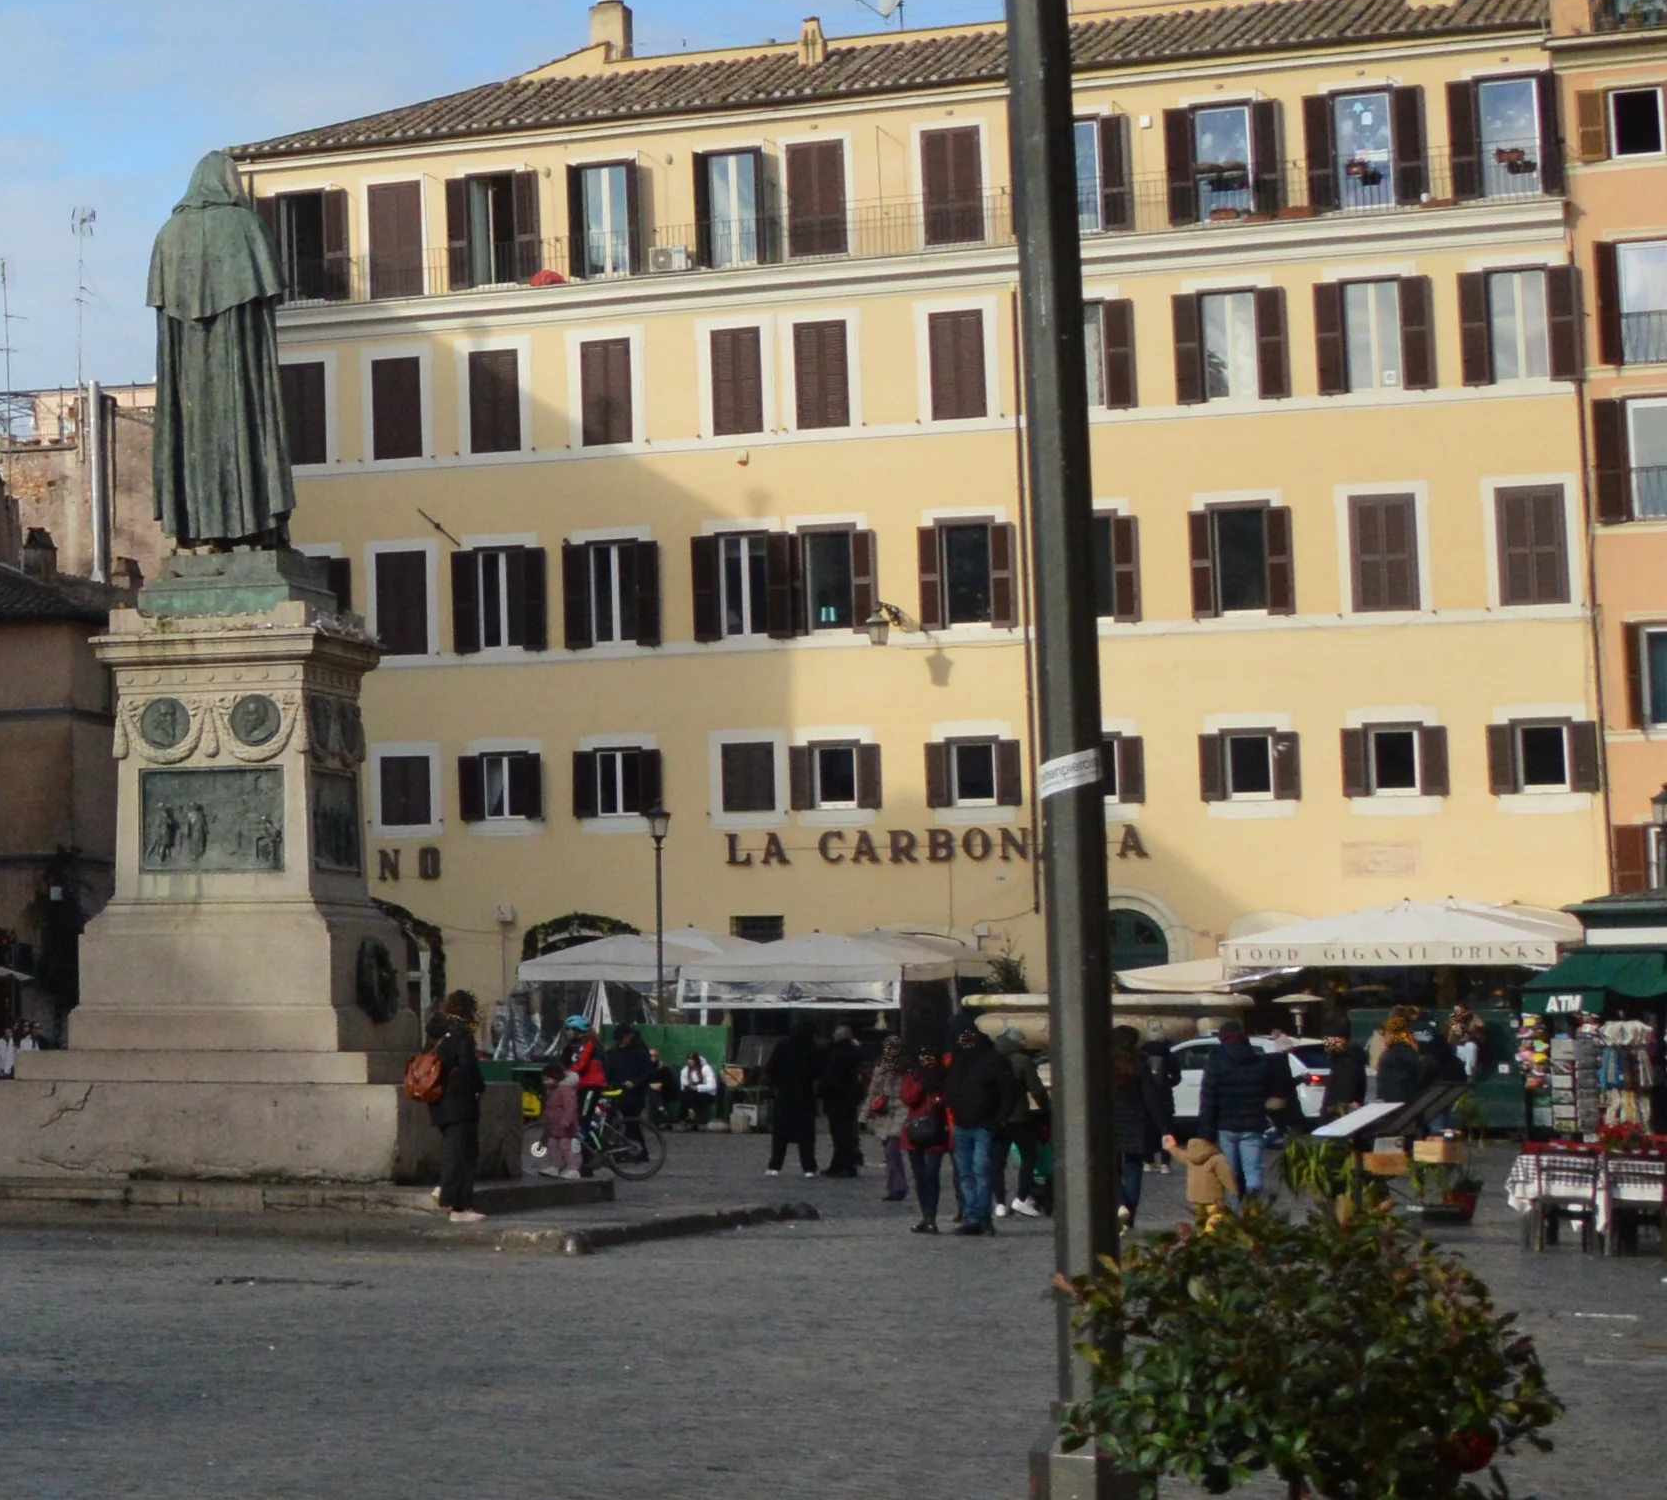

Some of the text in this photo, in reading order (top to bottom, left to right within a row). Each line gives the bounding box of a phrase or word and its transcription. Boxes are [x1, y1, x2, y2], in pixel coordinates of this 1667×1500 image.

[724, 823, 1151, 867] LA CARBONA
[1234, 947, 1300, 961] FOOD
[1452, 945, 1546, 960] DRINKS
[1545, 994, 1583, 1013] ATM
